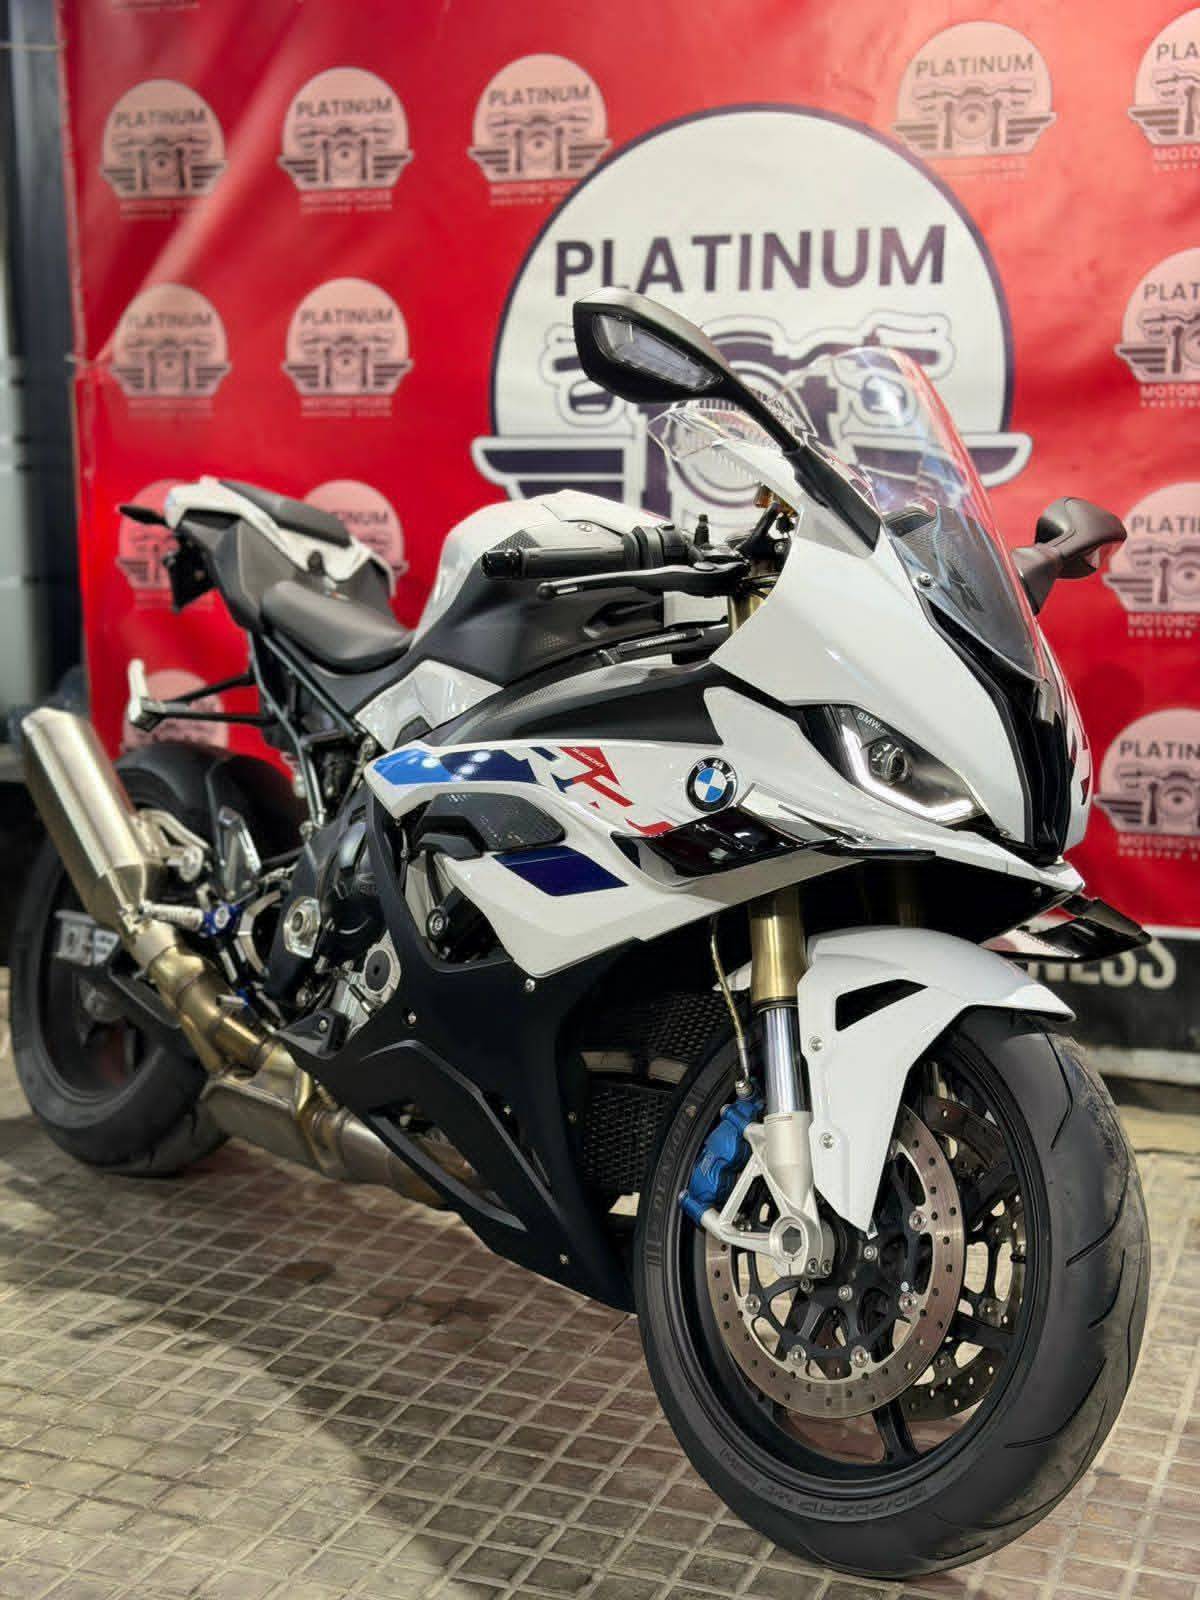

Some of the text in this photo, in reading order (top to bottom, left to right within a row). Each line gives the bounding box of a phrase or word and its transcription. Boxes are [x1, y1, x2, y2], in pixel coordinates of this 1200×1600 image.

[1156, 42, 1199, 61] PLA
[915, 53, 1033, 77] PLATINUM
[489, 84, 590, 106] PLATINUM
[297, 96, 393, 118] PLATINUM
[114, 108, 207, 128] PLATINUM
[555, 224, 947, 297] PLATINUM
[128, 311, 212, 328] PLATINUM
[301, 308, 393, 326] PLATINUM
[1131, 514, 1200, 534] PLATI
[696, 759, 736, 783] BMW
